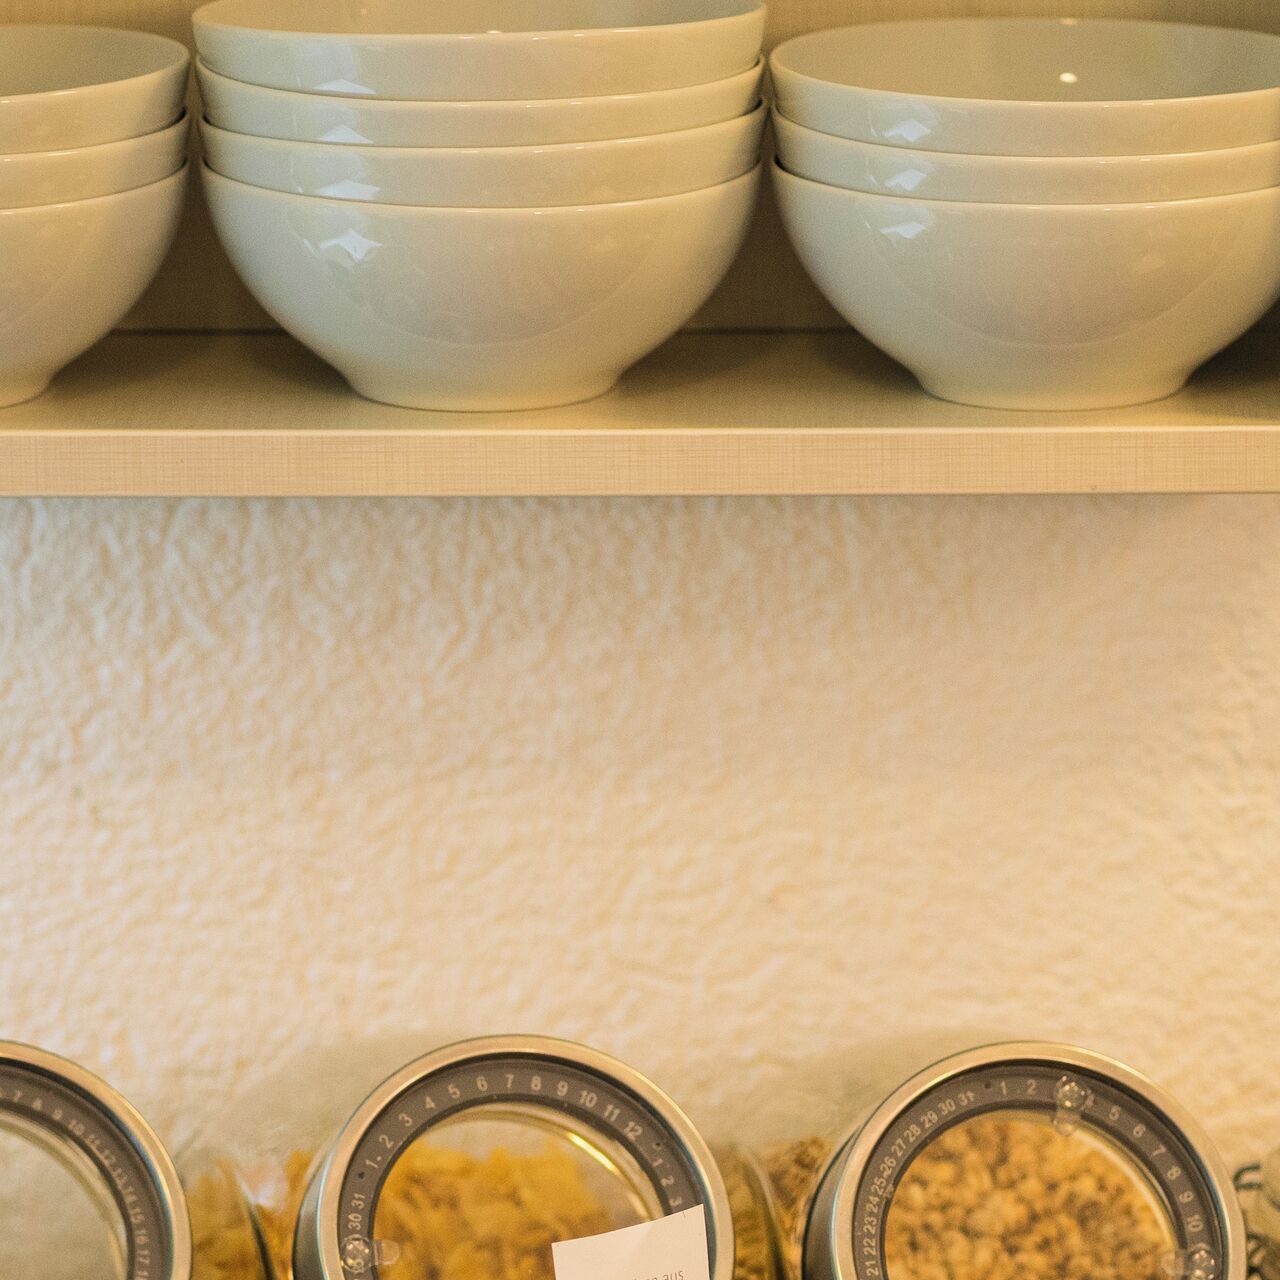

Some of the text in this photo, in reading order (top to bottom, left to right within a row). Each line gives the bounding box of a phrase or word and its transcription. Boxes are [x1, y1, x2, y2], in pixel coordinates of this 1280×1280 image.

[378, 1134, 394, 1149] 2
[398, 1113, 413, 1127] 3
[425, 1096, 436, 1109] 4
[447, 1083, 461, 1099] 5
[476, 1076, 488, 1092] 6
[505, 1073, 515, 1089] 7
[530, 1075, 542, 1092] 8
[556, 1081, 569, 1097] 9
[579, 1090, 598, 1108] 10
[603, 1104, 621, 1122] 11
[623, 1121, 643, 1141] 12
[937, 1098, 956, 1116] 30
[920, 1110, 939, 1129] 29
[903, 1124, 922, 1143] 28
[890, 1137, 907, 1158] 27
[999, 1081, 1007, 1096] 1
[1026, 1079, 1037, 1095] 2
[1132, 1124, 1146, 1138] 6
[1152, 1144, 1167, 1157] 7
[1166, 1166, 1181, 1181] 8
[1178, 1190, 1194, 1204] 9
[1186, 1214, 1203, 1233] 10
[652, 1157, 664, 1167] 1
[879, 1157, 897, 1175] 26
[660, 1175, 675, 1187] 2
[870, 1176, 887, 1196] 25
[351, 1192, 366, 1210] 31
[669, 1196, 683, 1207] 3
[865, 1195, 880, 1214] 24
[347, 1212, 362, 1231] 30
[863, 1216, 877, 1235] 23
[862, 1237, 877, 1256] 22
[864, 1260, 880, 1277] 21
